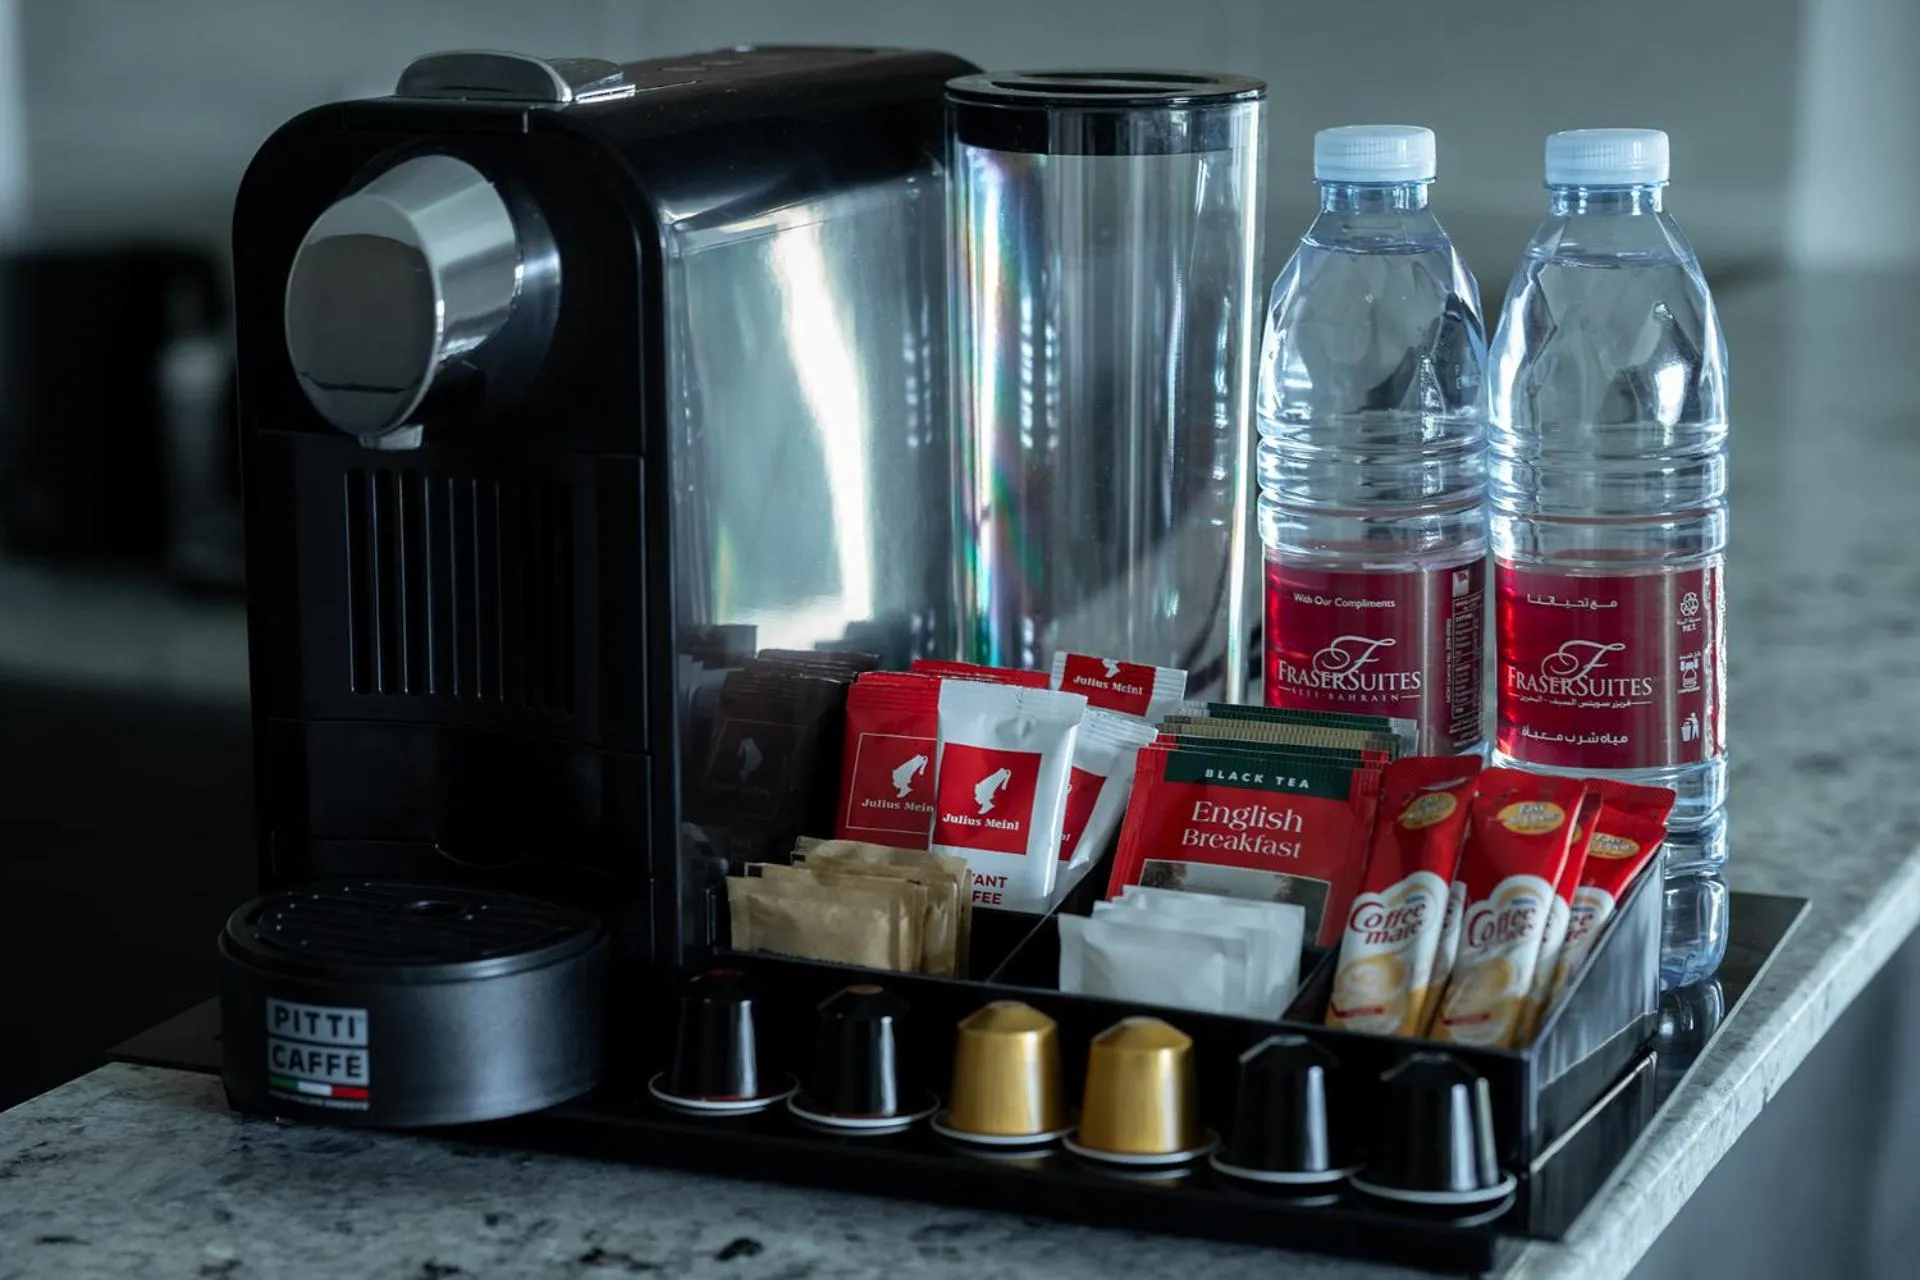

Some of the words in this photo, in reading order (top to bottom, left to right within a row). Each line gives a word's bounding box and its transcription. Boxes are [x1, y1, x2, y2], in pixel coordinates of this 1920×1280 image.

[1293, 592, 1313, 604] With
[1314, 595, 1332, 606] Our
[1334, 597, 1396, 609] Compliments
[1073, 675, 1109, 689] Julius
[1112, 682, 1144, 696] Meinl
[1204, 769, 1263, 784] BLACK
[1276, 776, 1311, 789] TEA
[861, 798, 900, 810] Julius
[904, 801, 935, 813] Mein
[942, 813, 981, 826] Julius
[985, 819, 1019, 831] Meinl
[1191, 800, 1304, 834] English
[1181, 828, 1301, 859] Breakfast
[972, 873, 1008, 889] ANT
[972, 891, 1002, 905] FEE
[274, 1005, 355, 1038] PITTI
[272, 1044, 362, 1079] CAFFE
